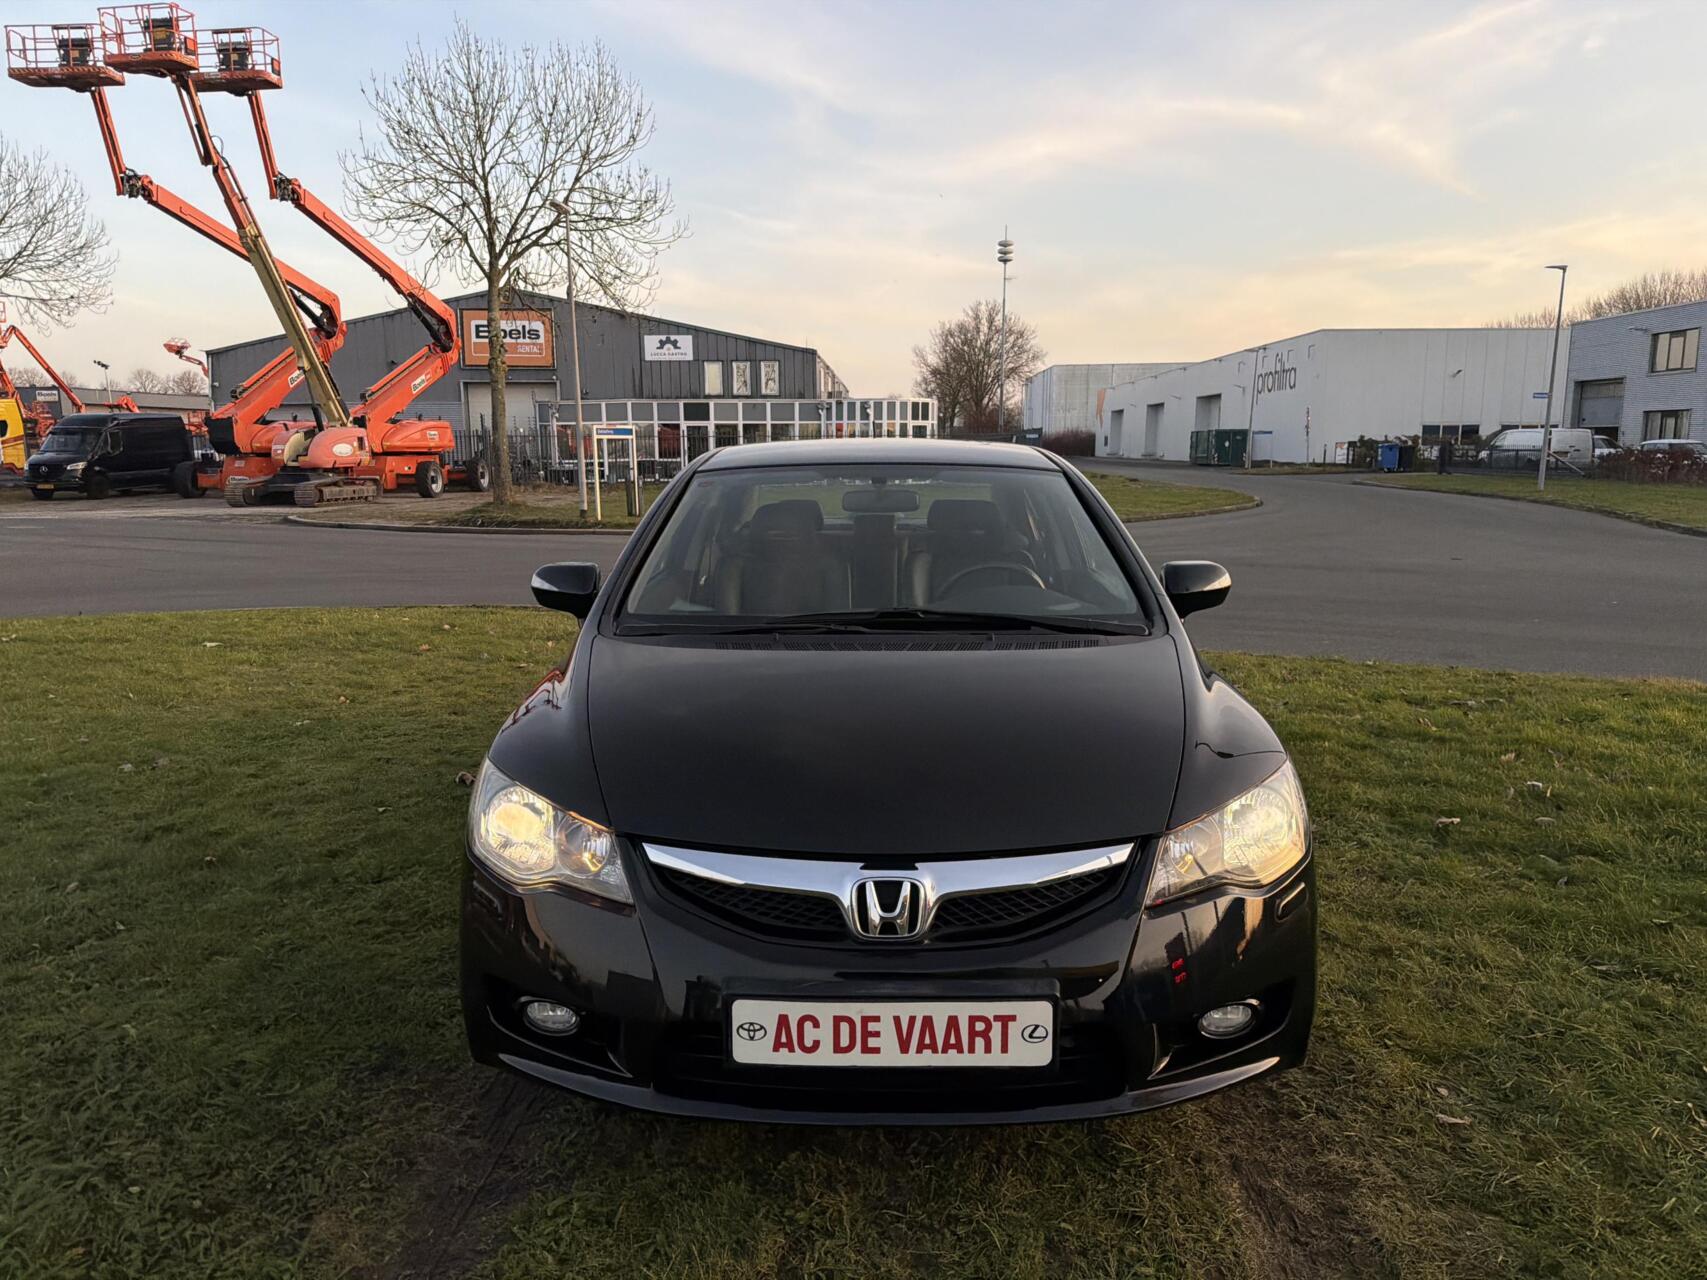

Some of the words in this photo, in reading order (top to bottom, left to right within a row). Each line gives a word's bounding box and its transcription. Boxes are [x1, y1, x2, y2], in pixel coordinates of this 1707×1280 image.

[1255, 351, 1297, 405] profiltra
[772, 1013, 821, 1054] AC
[832, 1015, 881, 1054] DE
[892, 1014, 1017, 1055] VAART
